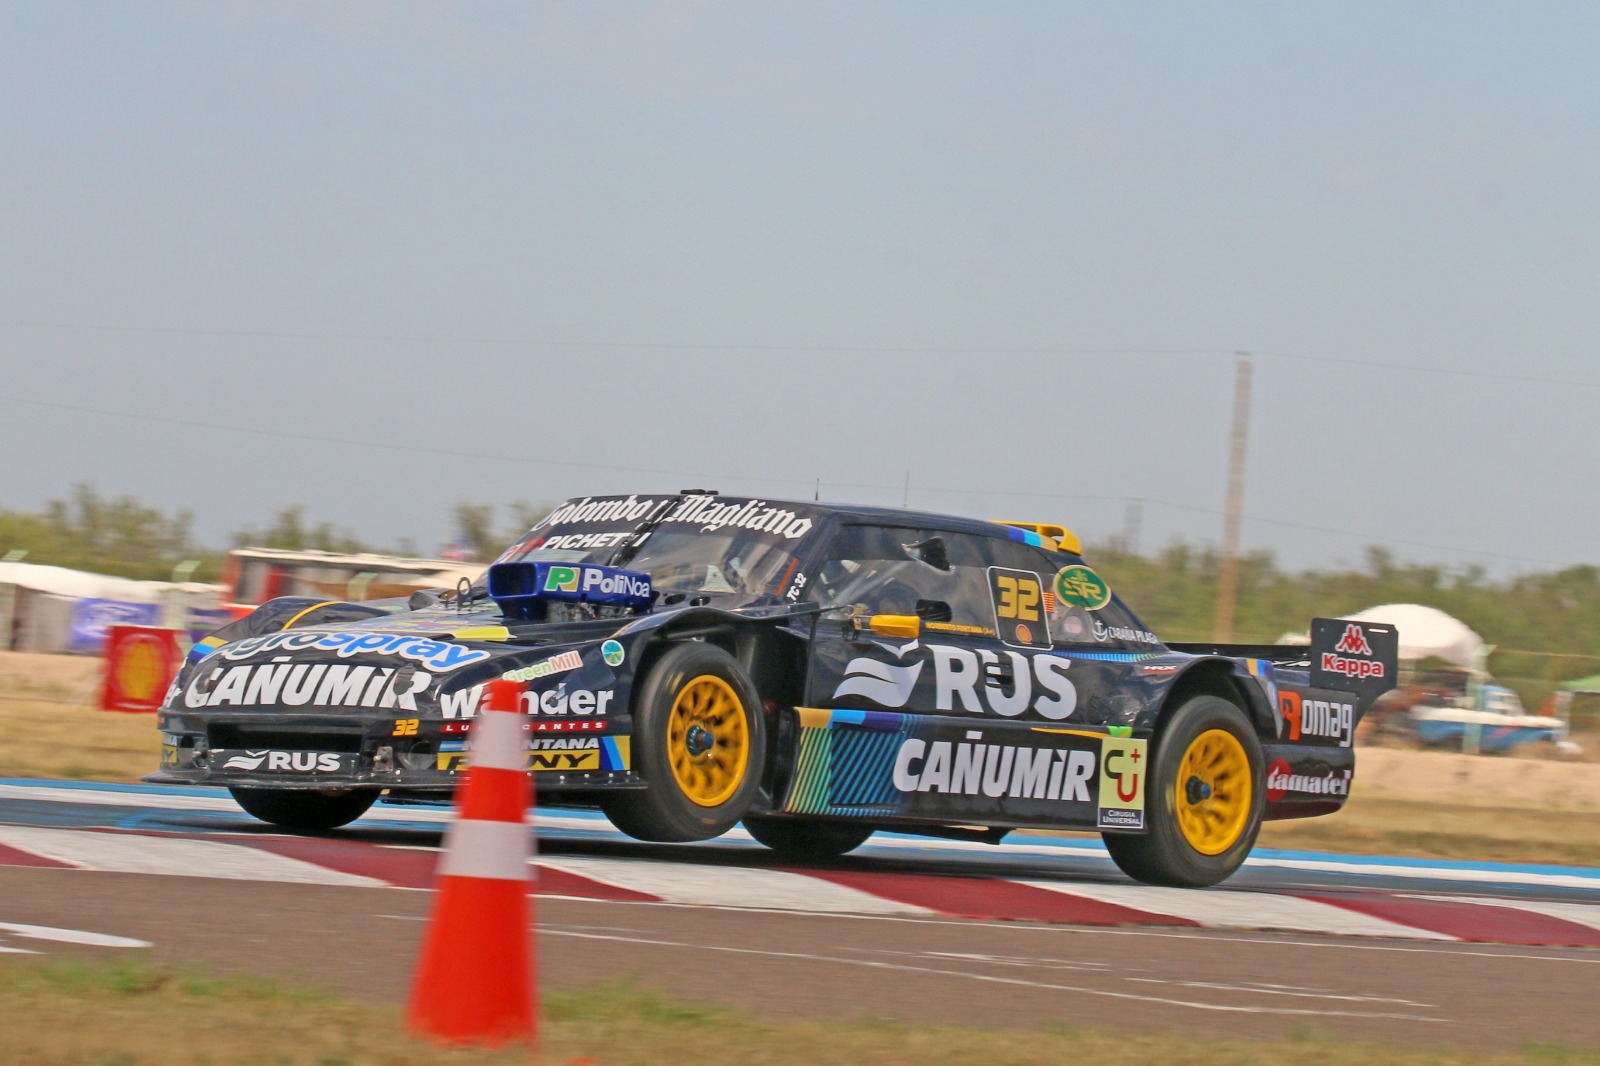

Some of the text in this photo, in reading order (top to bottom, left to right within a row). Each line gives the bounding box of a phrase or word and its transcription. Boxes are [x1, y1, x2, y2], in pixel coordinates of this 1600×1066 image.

[660, 494, 813, 539] Magliano
[539, 532, 652, 550] PICHETI
[583, 568, 650, 597] PoliNoa
[997, 576, 1040, 622] 32
[1322, 653, 1384, 678] Kappa
[926, 644, 1078, 720] RUS
[392, 719, 419, 736] 32
[268, 751, 341, 771] RUS
[447, 753, 593, 770] FNY
